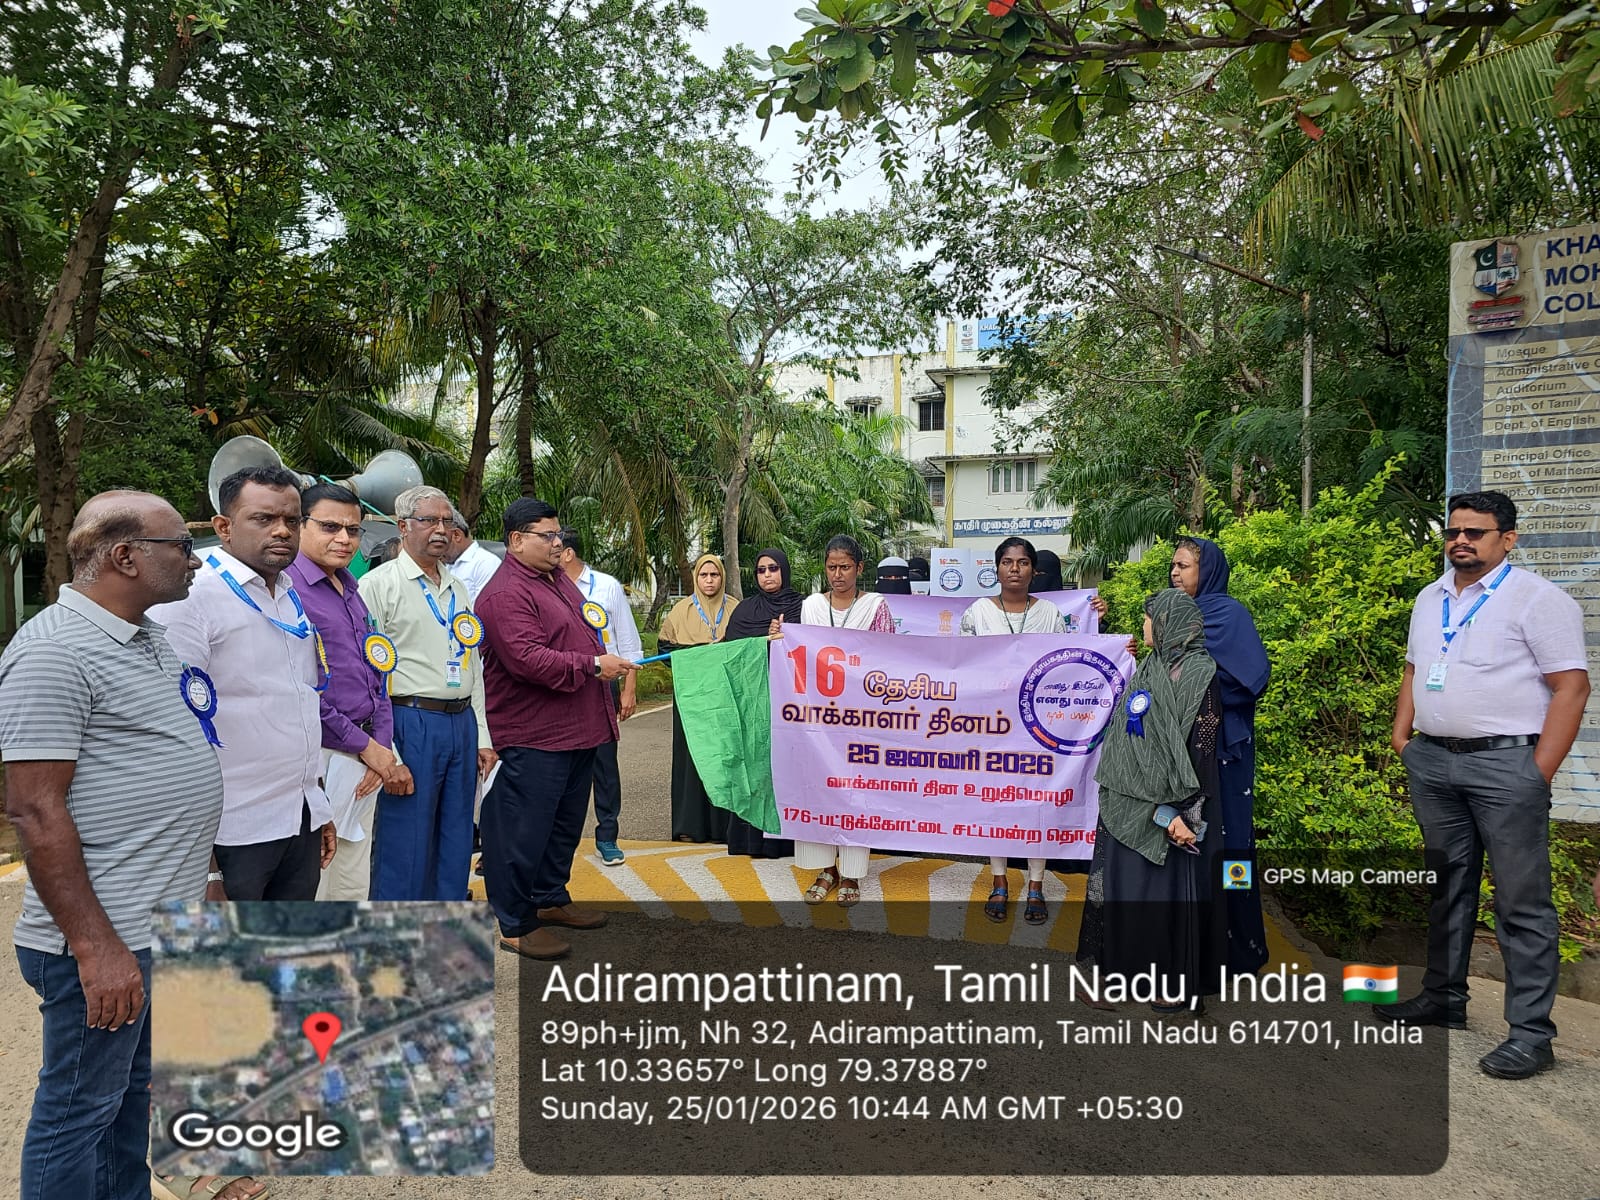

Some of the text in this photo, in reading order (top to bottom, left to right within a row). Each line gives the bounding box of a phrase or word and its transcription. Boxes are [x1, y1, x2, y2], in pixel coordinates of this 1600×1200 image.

[1547, 234, 1600, 259] KHA
[1544, 291, 1600, 315] COL
[1497, 346, 1546, 359] Mosque
[1497, 361, 1589, 377] Administrative
[1497, 381, 1566, 395] Auditorium
[1496, 398, 1581, 415] Dept. of Tamil
[1495, 415, 1595, 433] Dept. of English
[1494, 448, 1591, 464] Principal Office
[1494, 470, 1525, 481] Dept.
[1529, 467, 1541, 477] of
[1498, 487, 1524, 498] ept.
[1528, 486, 1540, 496] of
[1528, 503, 1539, 513] of
[1544, 503, 1592, 514] Physics
[1527, 521, 1538, 530] of
[1543, 521, 1587, 531] History
[1527, 551, 1539, 560] of
[1542, 568, 1578, 577] Home
[863, 670, 957, 706] தேசிய
[1036, 696, 1111, 708] எனது வாக்கு
[782, 701, 1012, 738] வாக்காளர் தினம்
[848, 743, 1054, 776] 25 ஜனவரி 2026
[827, 774, 1074, 807] வாக்காளர் தின உறுதிமொழி
[783, 807, 948, 835] 176-பட்டுக்கோட்டை
[952, 824, 1042, 844] சட்டமன்ற
